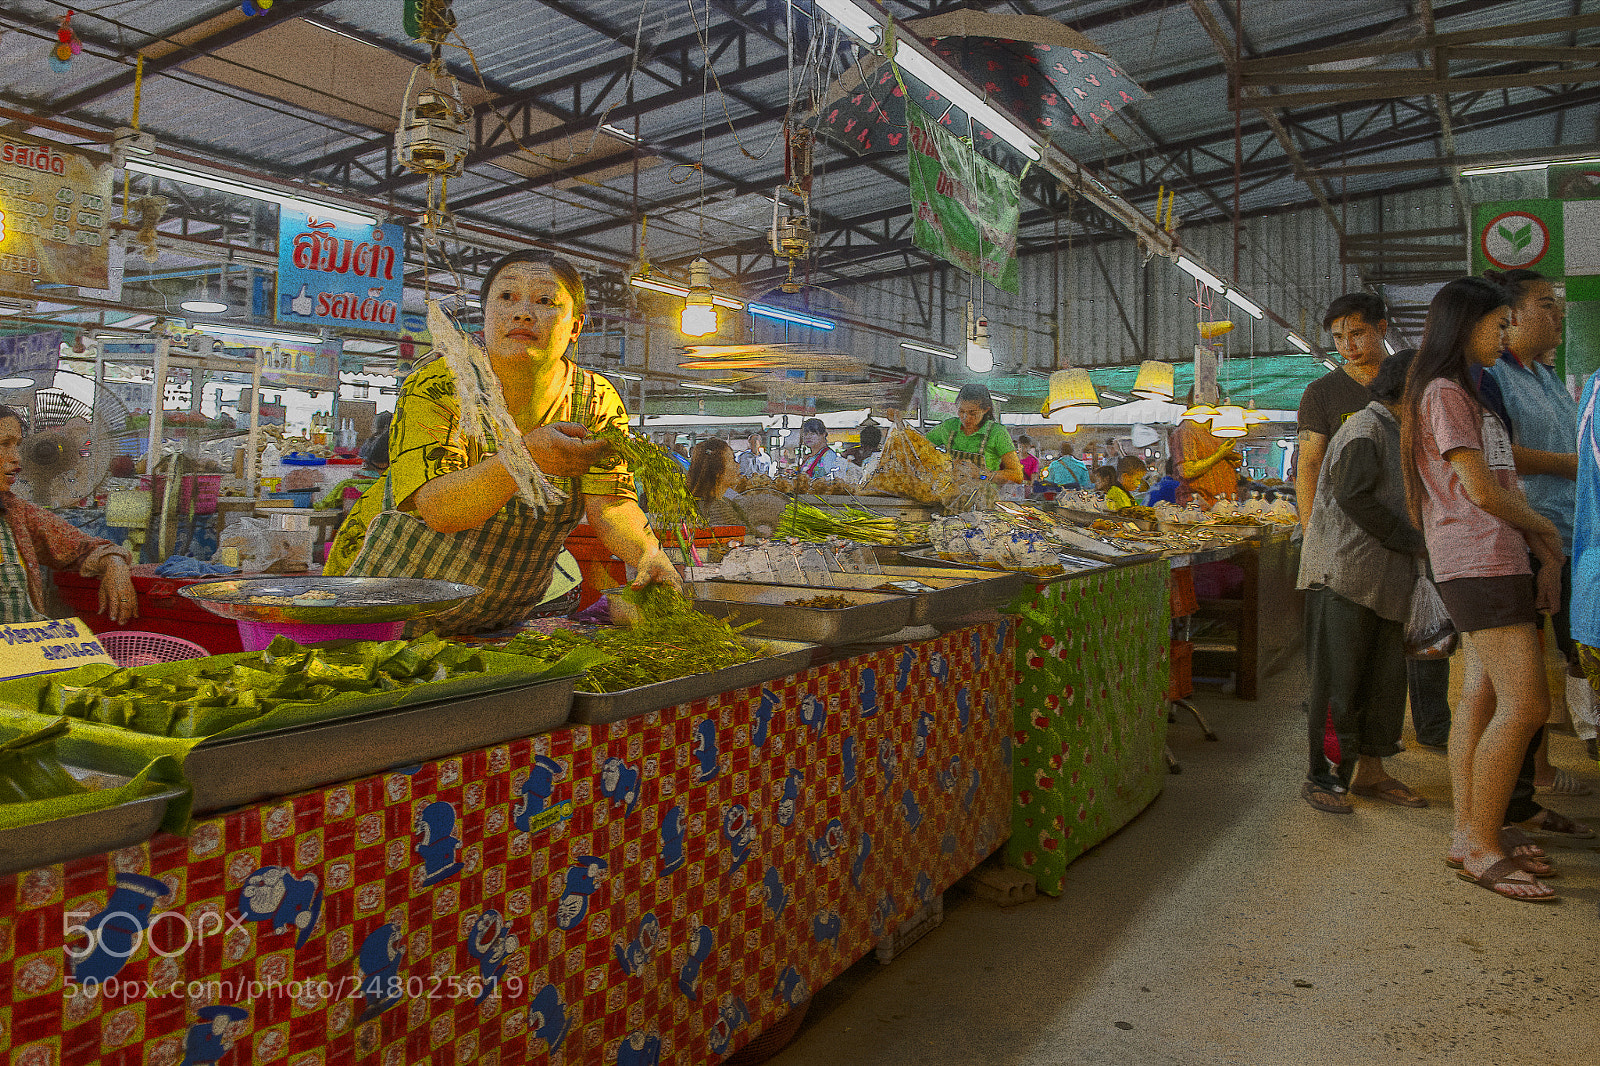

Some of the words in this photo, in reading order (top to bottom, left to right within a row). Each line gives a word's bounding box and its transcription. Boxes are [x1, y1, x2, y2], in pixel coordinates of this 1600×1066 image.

[2, 144, 66, 175] รสเด็ด
[293, 215, 395, 280] ส้มตำ
[315, 286, 398, 324] รสเด็ด
